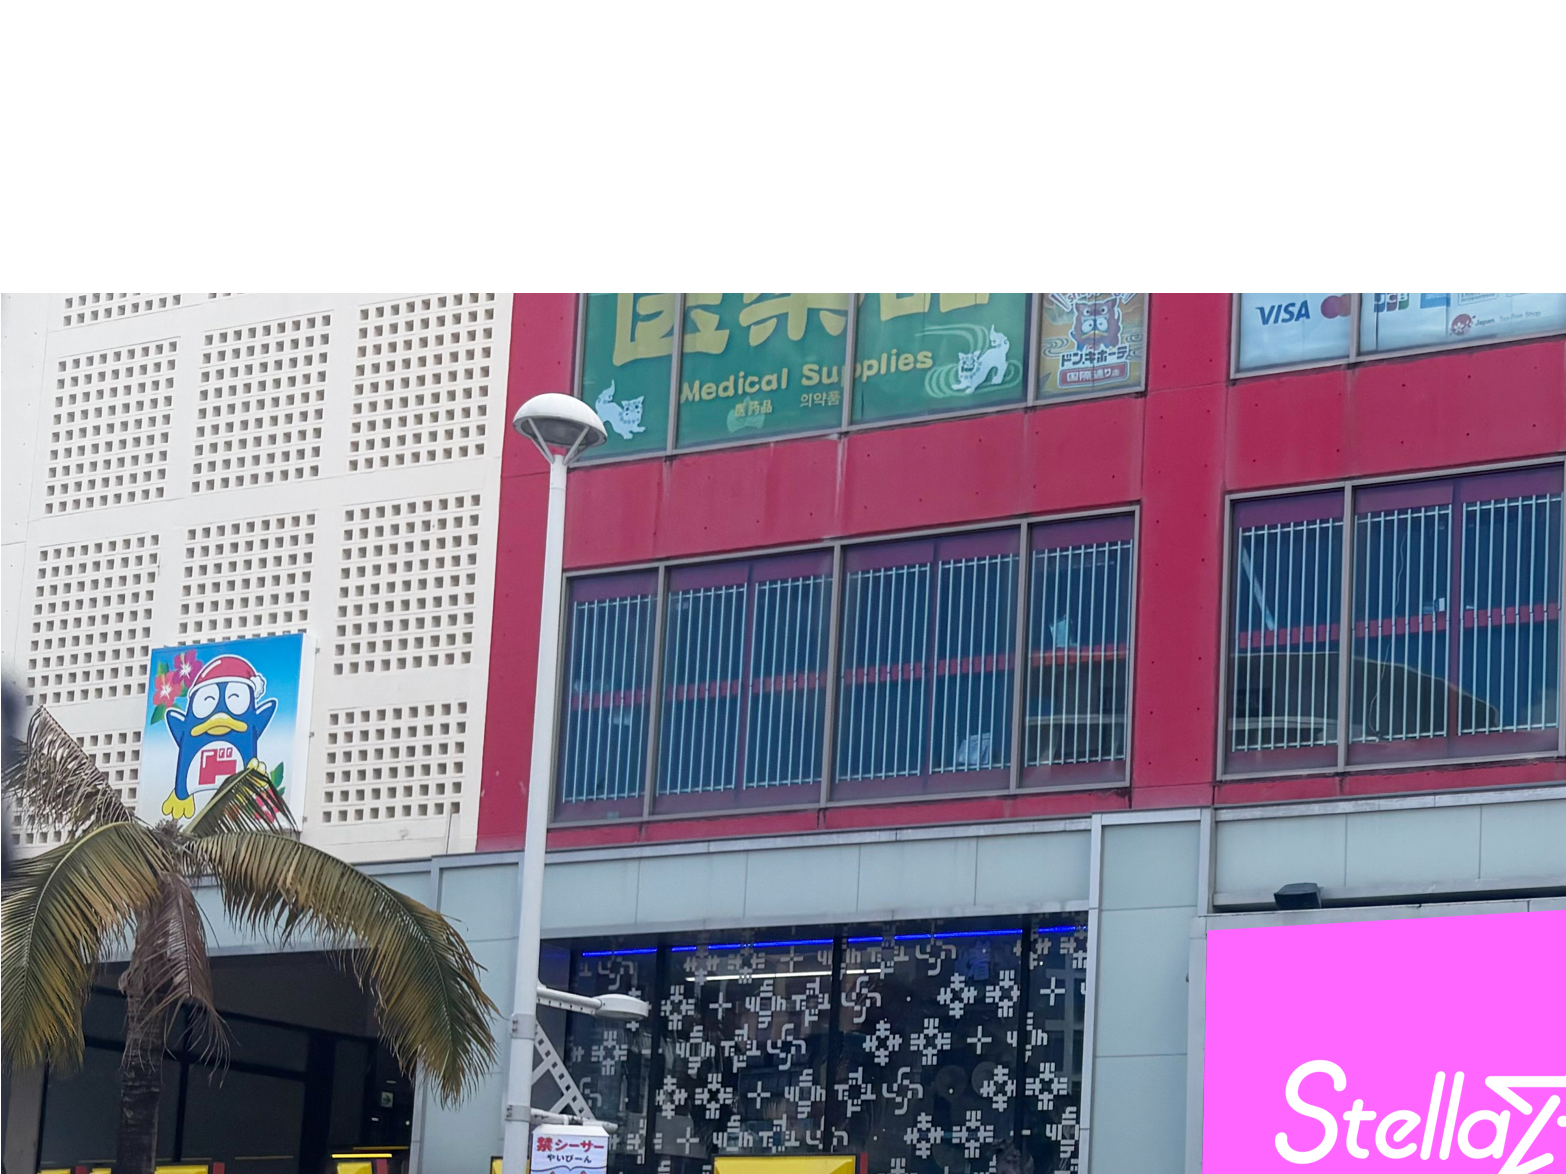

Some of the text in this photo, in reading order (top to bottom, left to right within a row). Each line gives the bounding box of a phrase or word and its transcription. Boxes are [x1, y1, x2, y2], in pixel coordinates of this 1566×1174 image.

[1255, 299, 1311, 326] VISA
[681, 349, 934, 404] Medical Supplies
